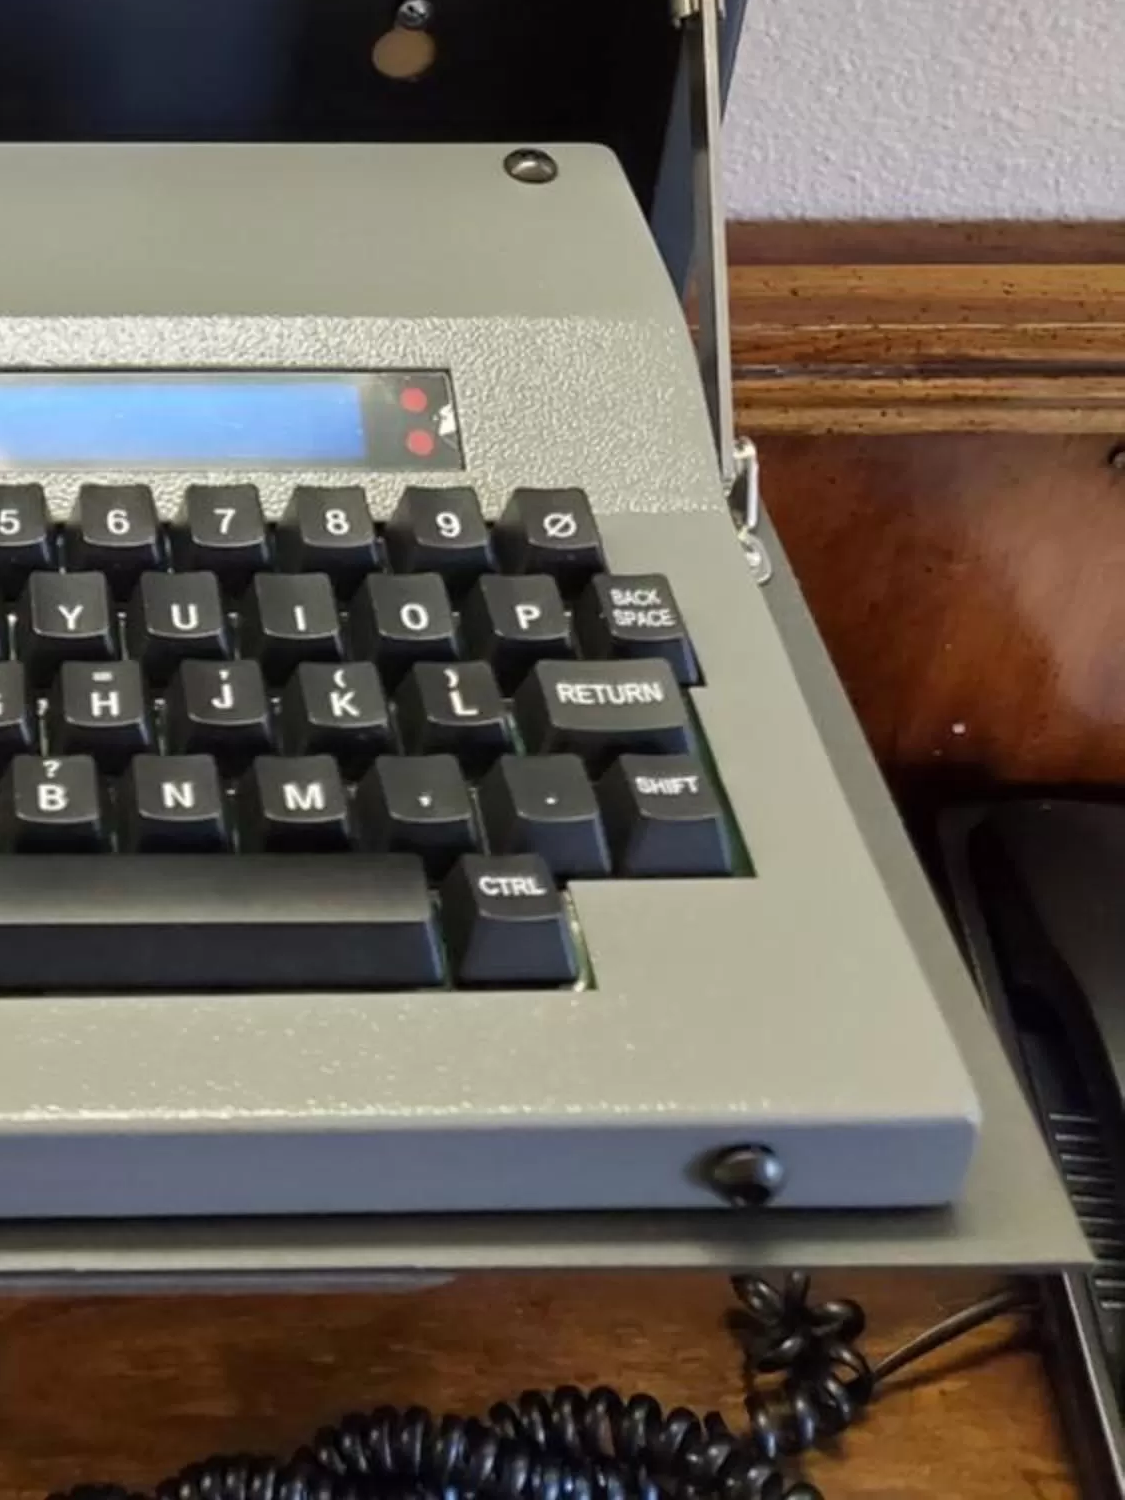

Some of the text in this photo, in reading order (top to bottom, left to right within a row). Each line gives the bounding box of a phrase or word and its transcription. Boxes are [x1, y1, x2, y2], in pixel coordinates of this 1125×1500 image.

[106, 509, 130, 535] 6
[214, 508, 236, 534] 7
[325, 509, 350, 535] 8
[436, 512, 461, 538] 9
[610, 589, 661, 606] BACK
[58, 605, 84, 630] Y
[171, 604, 198, 630] U
[515, 604, 541, 629] P
[611, 606, 675, 628] SPACE
[91, 691, 119, 717] H
[212, 683, 233, 709] J
[330, 691, 359, 717] K
[450, 690, 478, 716] L
[556, 682, 664, 704] RETURN
[42, 759, 61, 778] ?
[38, 784, 66, 811] B
[162, 782, 193, 808] N
[284, 783, 324, 810] M
[635, 775, 698, 794] SHIFT
[479, 876, 545, 895] CTRL
